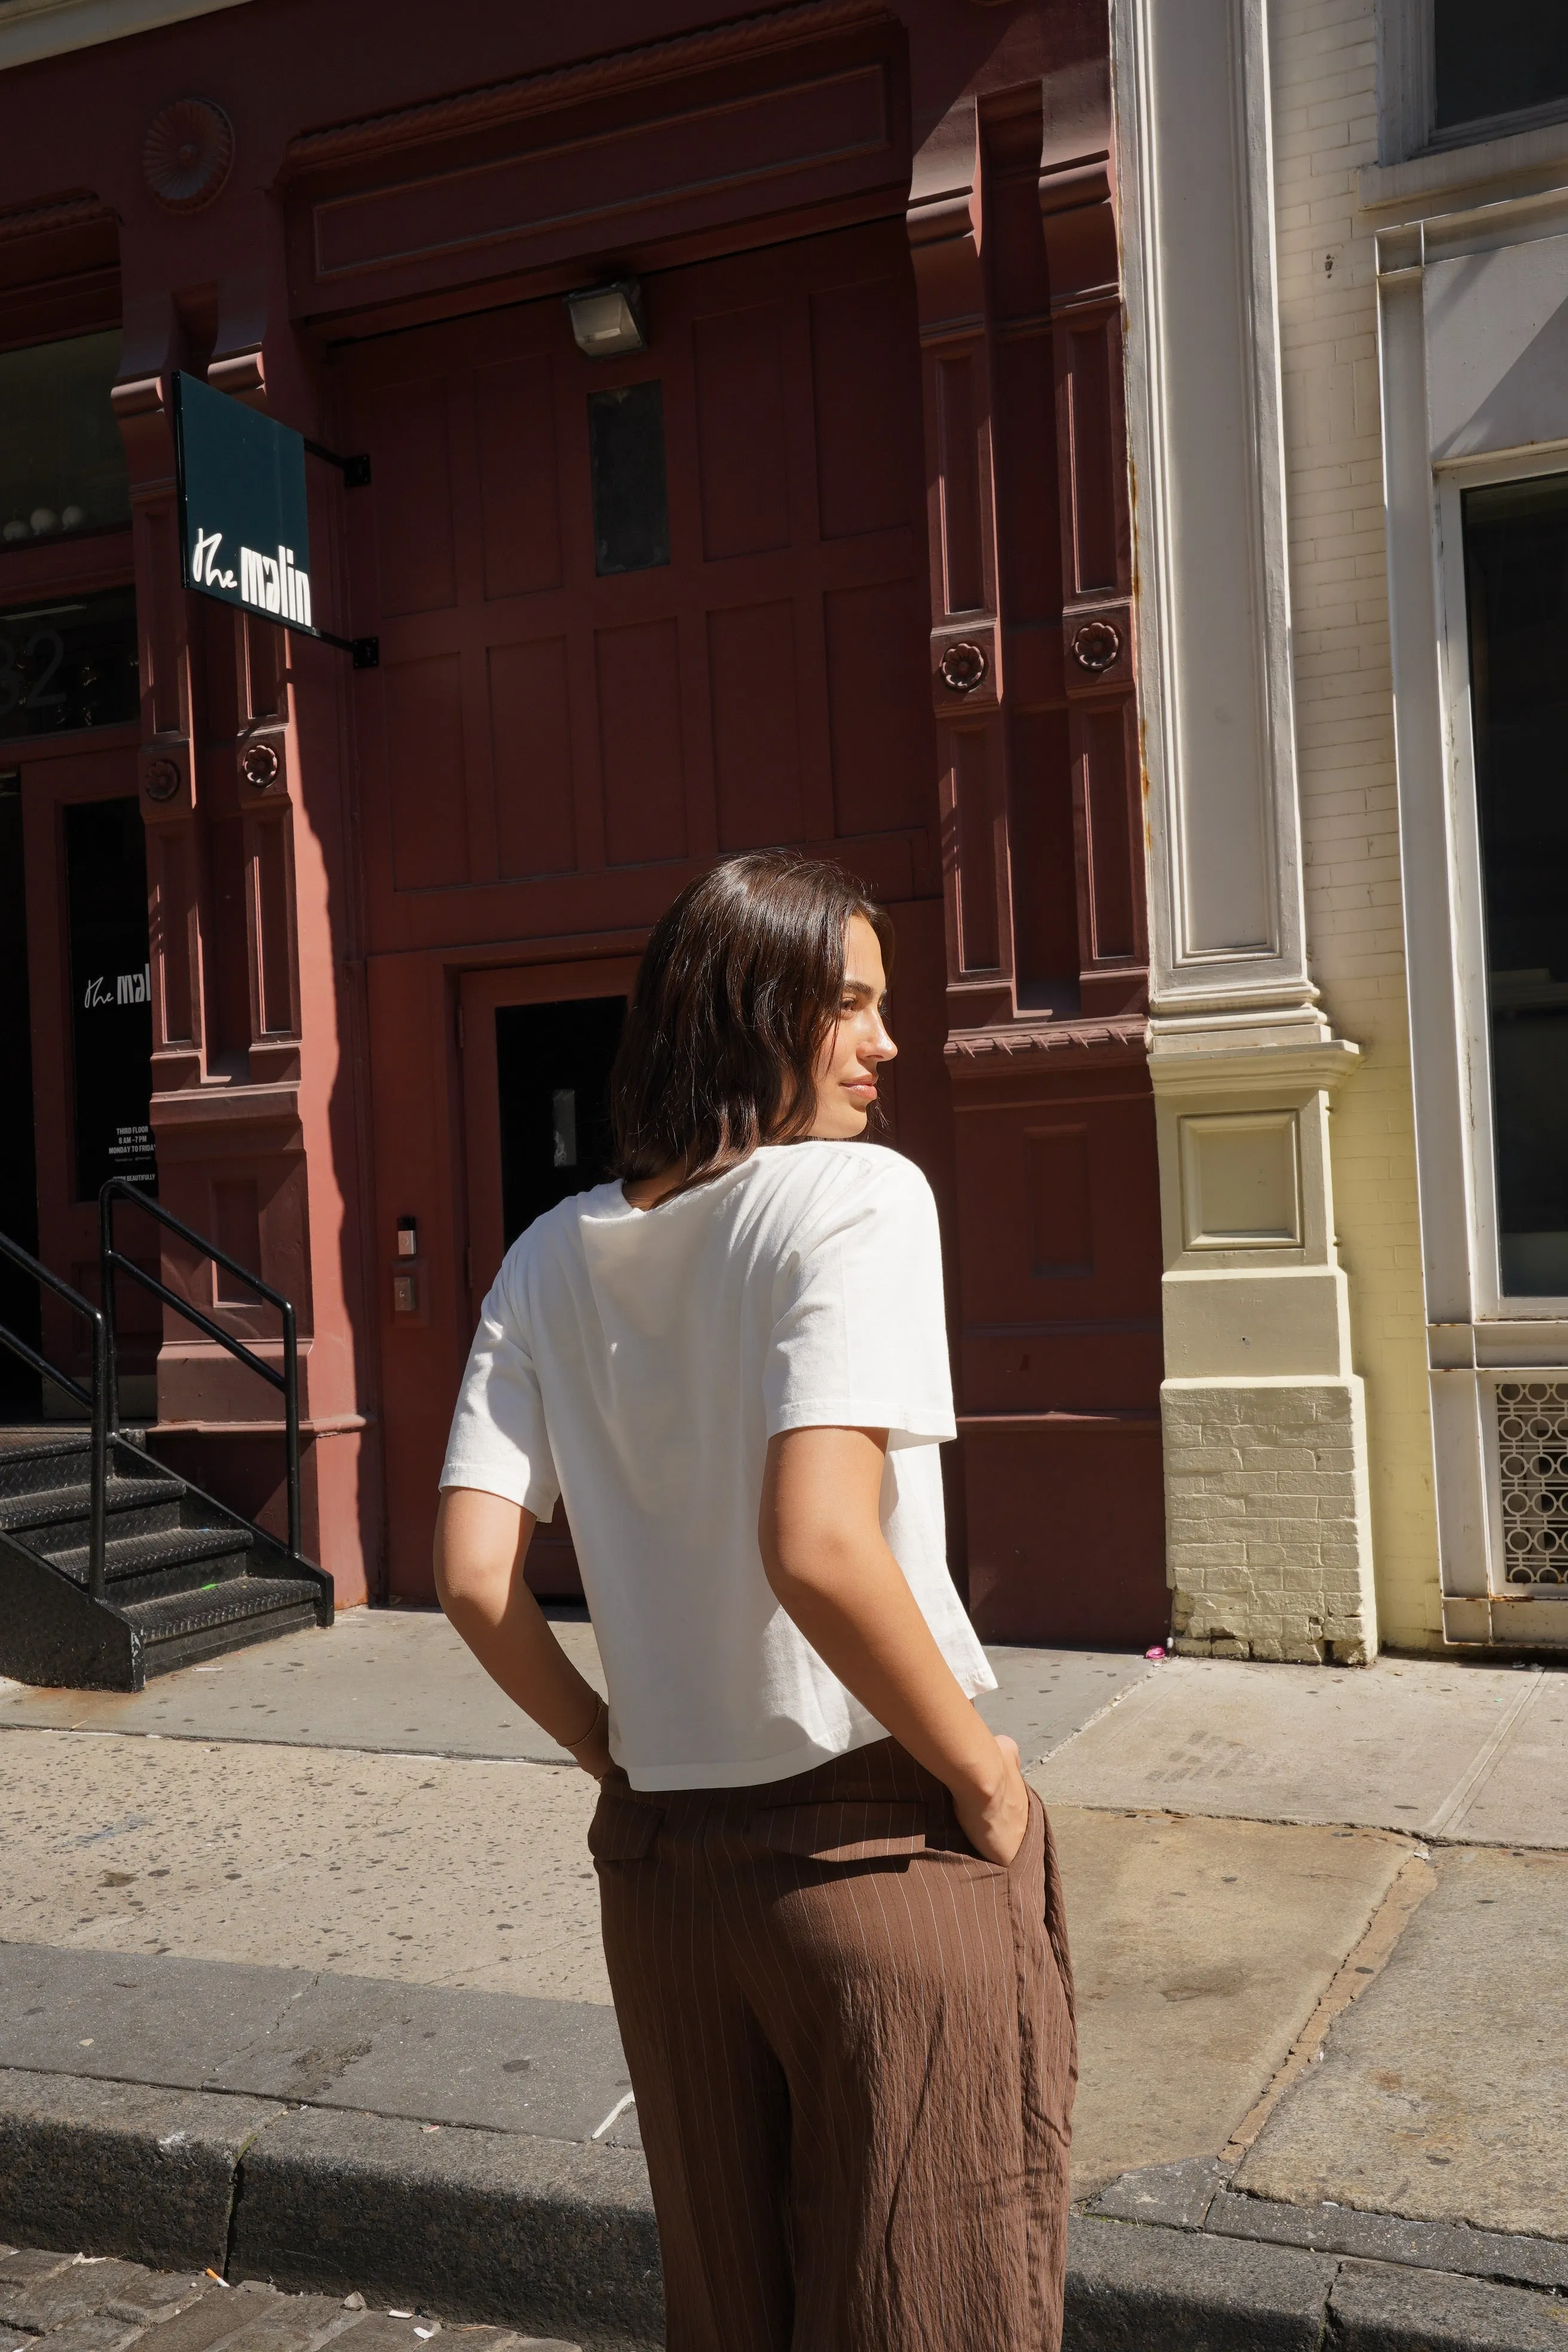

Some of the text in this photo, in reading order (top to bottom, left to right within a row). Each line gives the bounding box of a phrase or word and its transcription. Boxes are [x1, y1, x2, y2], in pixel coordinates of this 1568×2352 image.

[192, 528, 311, 627] the malin
[84, 976, 114, 1008] the
